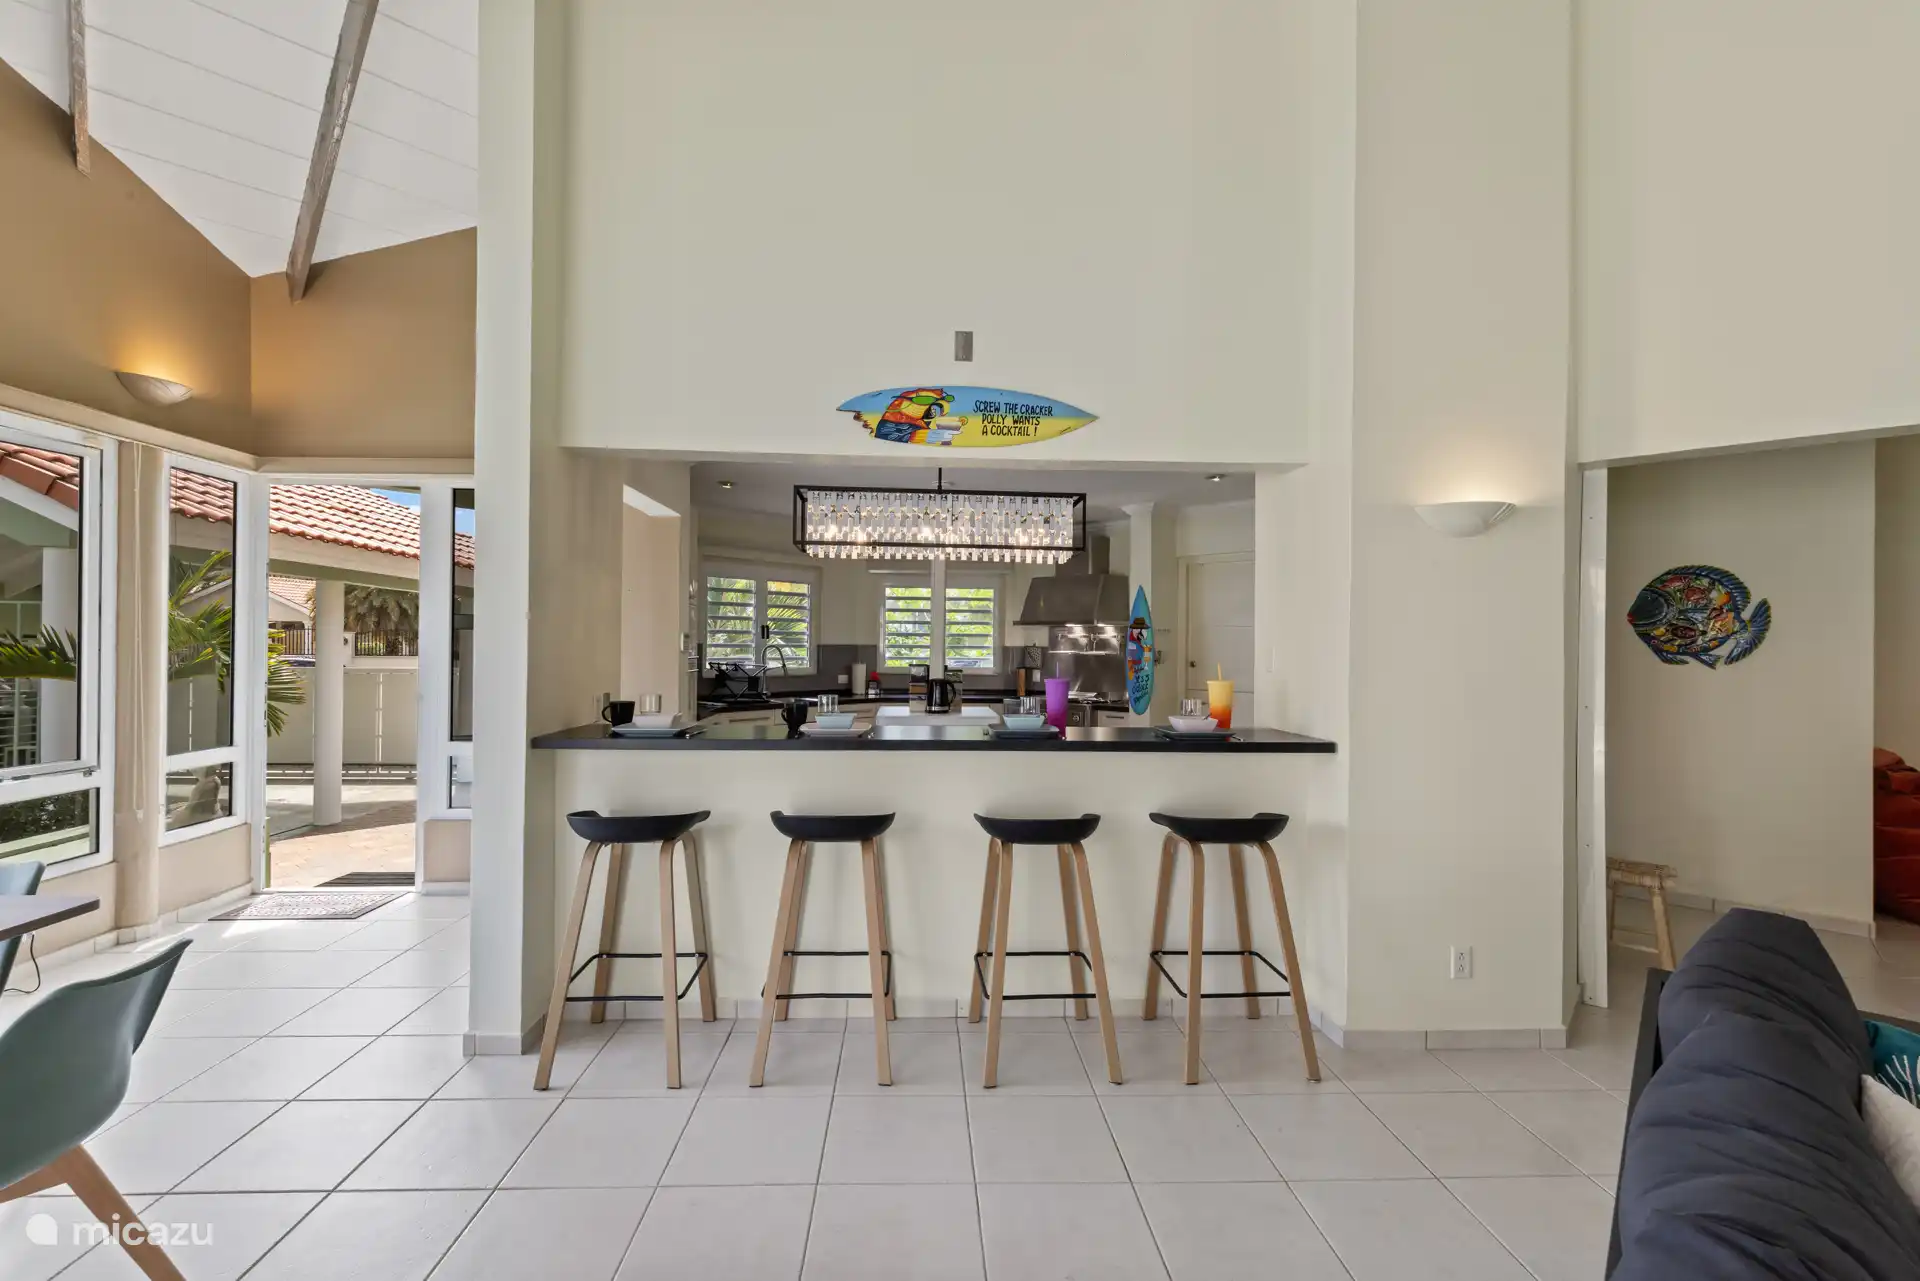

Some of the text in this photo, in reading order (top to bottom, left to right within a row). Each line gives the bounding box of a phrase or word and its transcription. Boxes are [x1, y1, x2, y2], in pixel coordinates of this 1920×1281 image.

[973, 400, 1053, 416] SCREW THE CRACKER
[982, 414, 1041, 426] POLLY WANTS
[982, 425, 988, 436] A
[990, 425, 1030, 436] COCKTAIL
